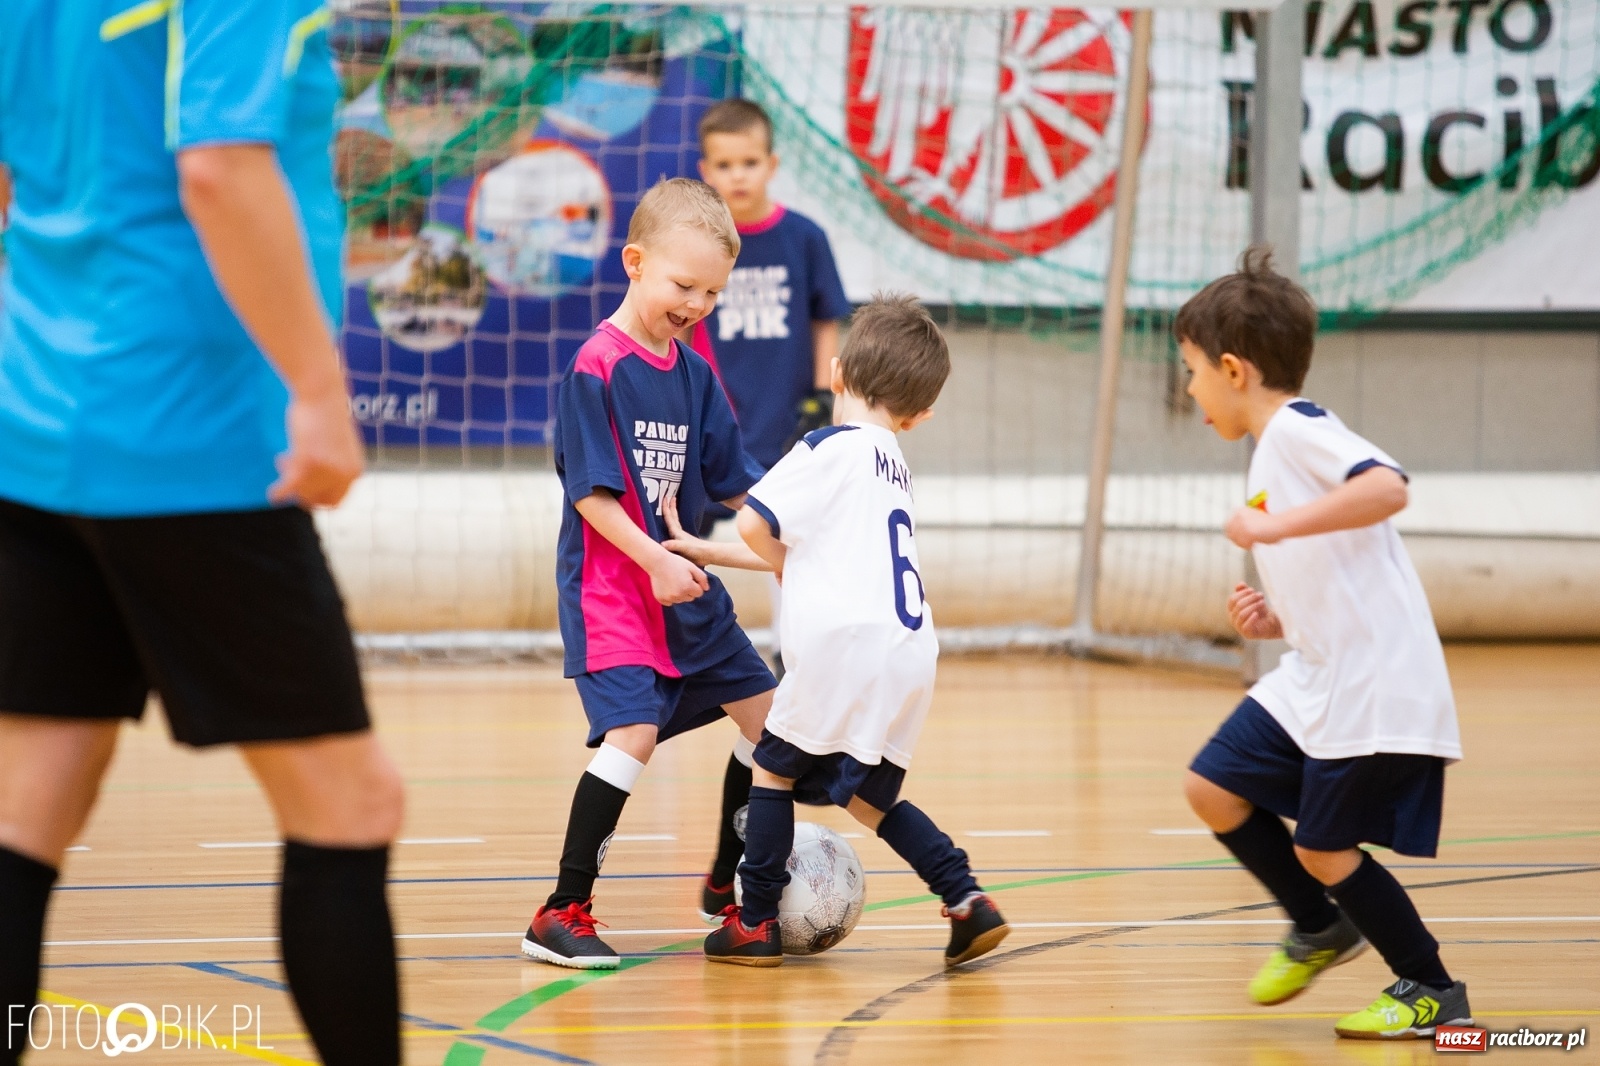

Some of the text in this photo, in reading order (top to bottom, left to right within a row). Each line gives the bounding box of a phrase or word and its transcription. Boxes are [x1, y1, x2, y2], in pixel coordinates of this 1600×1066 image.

[717, 307, 790, 340] PIK
[348, 389, 438, 427] orz.pl
[634, 420, 689, 442] PAWILO
[874, 444, 914, 504] MAK
[887, 508, 925, 631] 6
